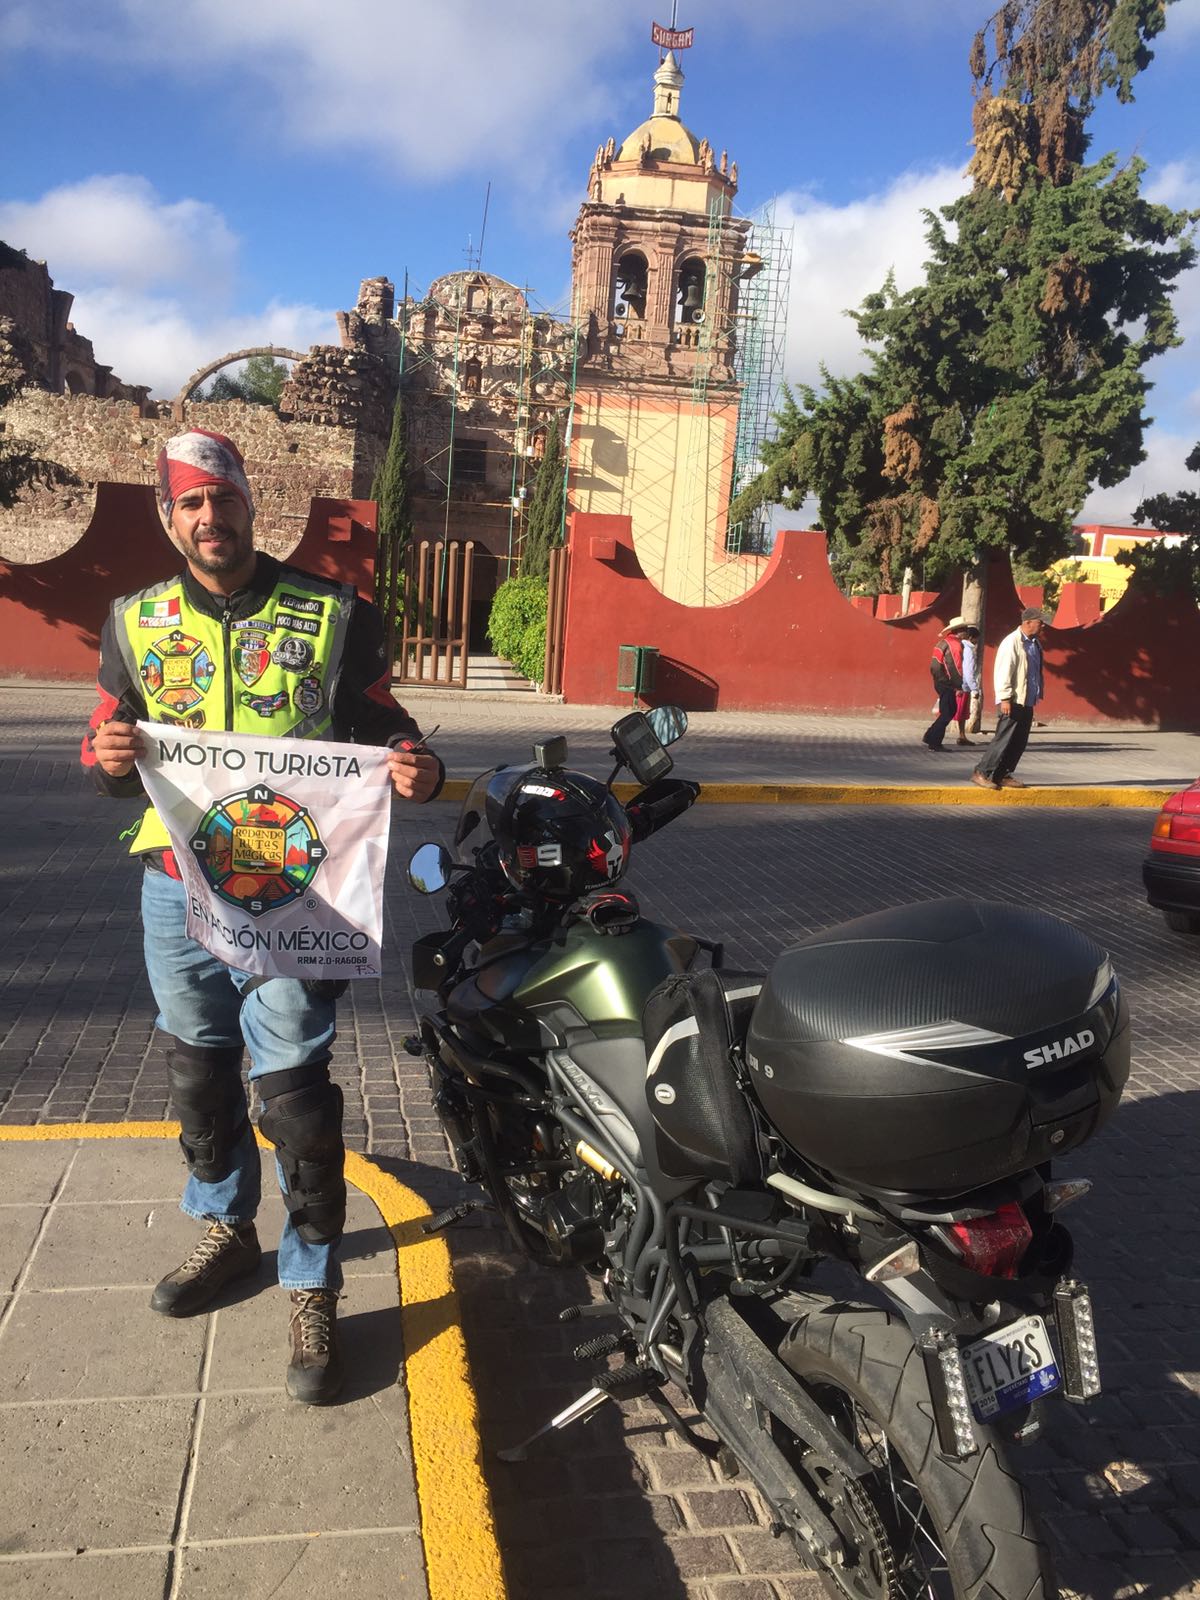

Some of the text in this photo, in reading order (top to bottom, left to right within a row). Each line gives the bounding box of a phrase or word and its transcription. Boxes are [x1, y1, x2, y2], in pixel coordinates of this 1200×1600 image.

[653, 27, 692, 47] SURGAM
[283, 597, 319, 611] FERNANDO
[303, 620, 318, 632] ALTO
[159, 740, 362, 778] MOTO TURISTA
[254, 790, 268, 800] N
[193, 840, 206, 850] O
[311, 848, 322, 858] E
[250, 901, 262, 910] S
[191, 896, 209, 923] EN
[278, 926, 369, 951] MÉXICO
[297, 956, 317, 965] RRM
[1023, 1029, 1095, 1070] SHAD
[974, 1333, 1043, 1395] ELY2S
